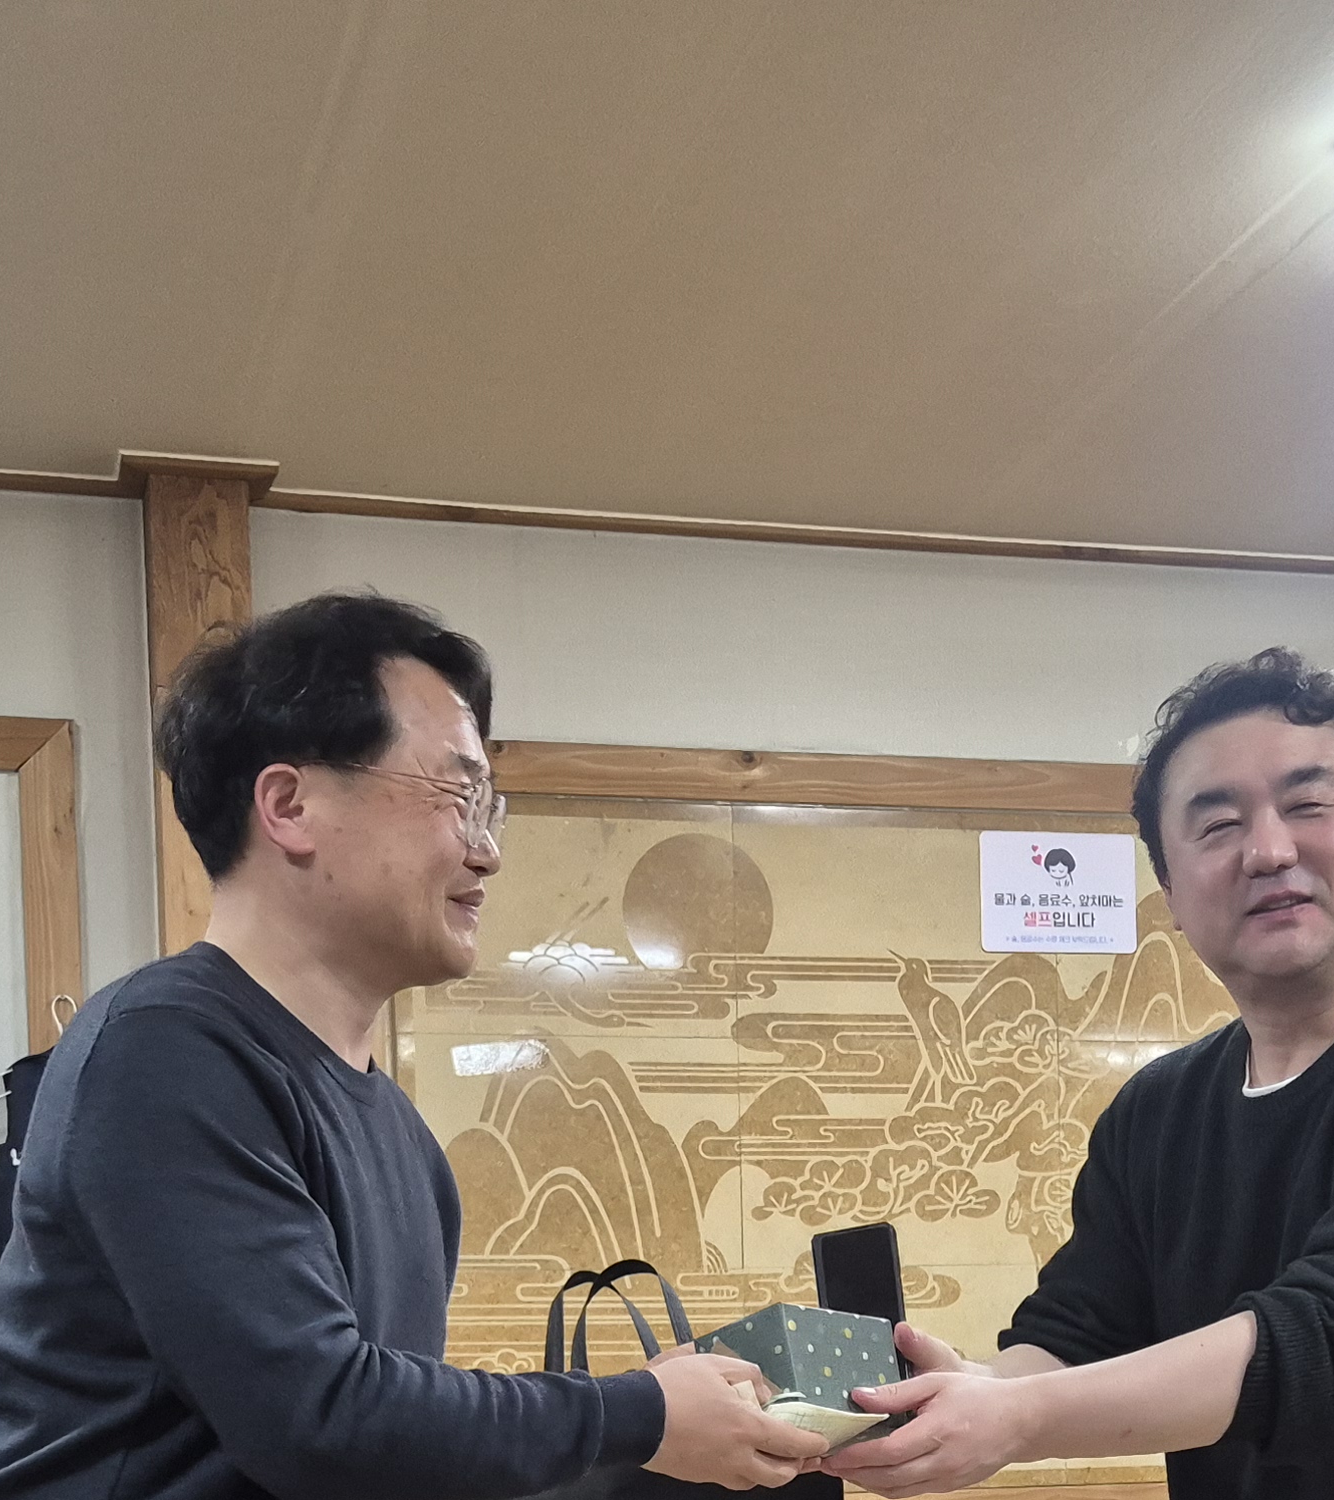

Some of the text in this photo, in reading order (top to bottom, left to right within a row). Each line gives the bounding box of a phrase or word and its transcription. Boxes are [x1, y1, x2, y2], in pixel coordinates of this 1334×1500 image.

[995, 893, 1016, 906] 물과
[1039, 894, 1075, 907] 음료수,
[1079, 894, 1123, 908] 앞치마는
[1024, 912, 1095, 927] 셀프입니다
